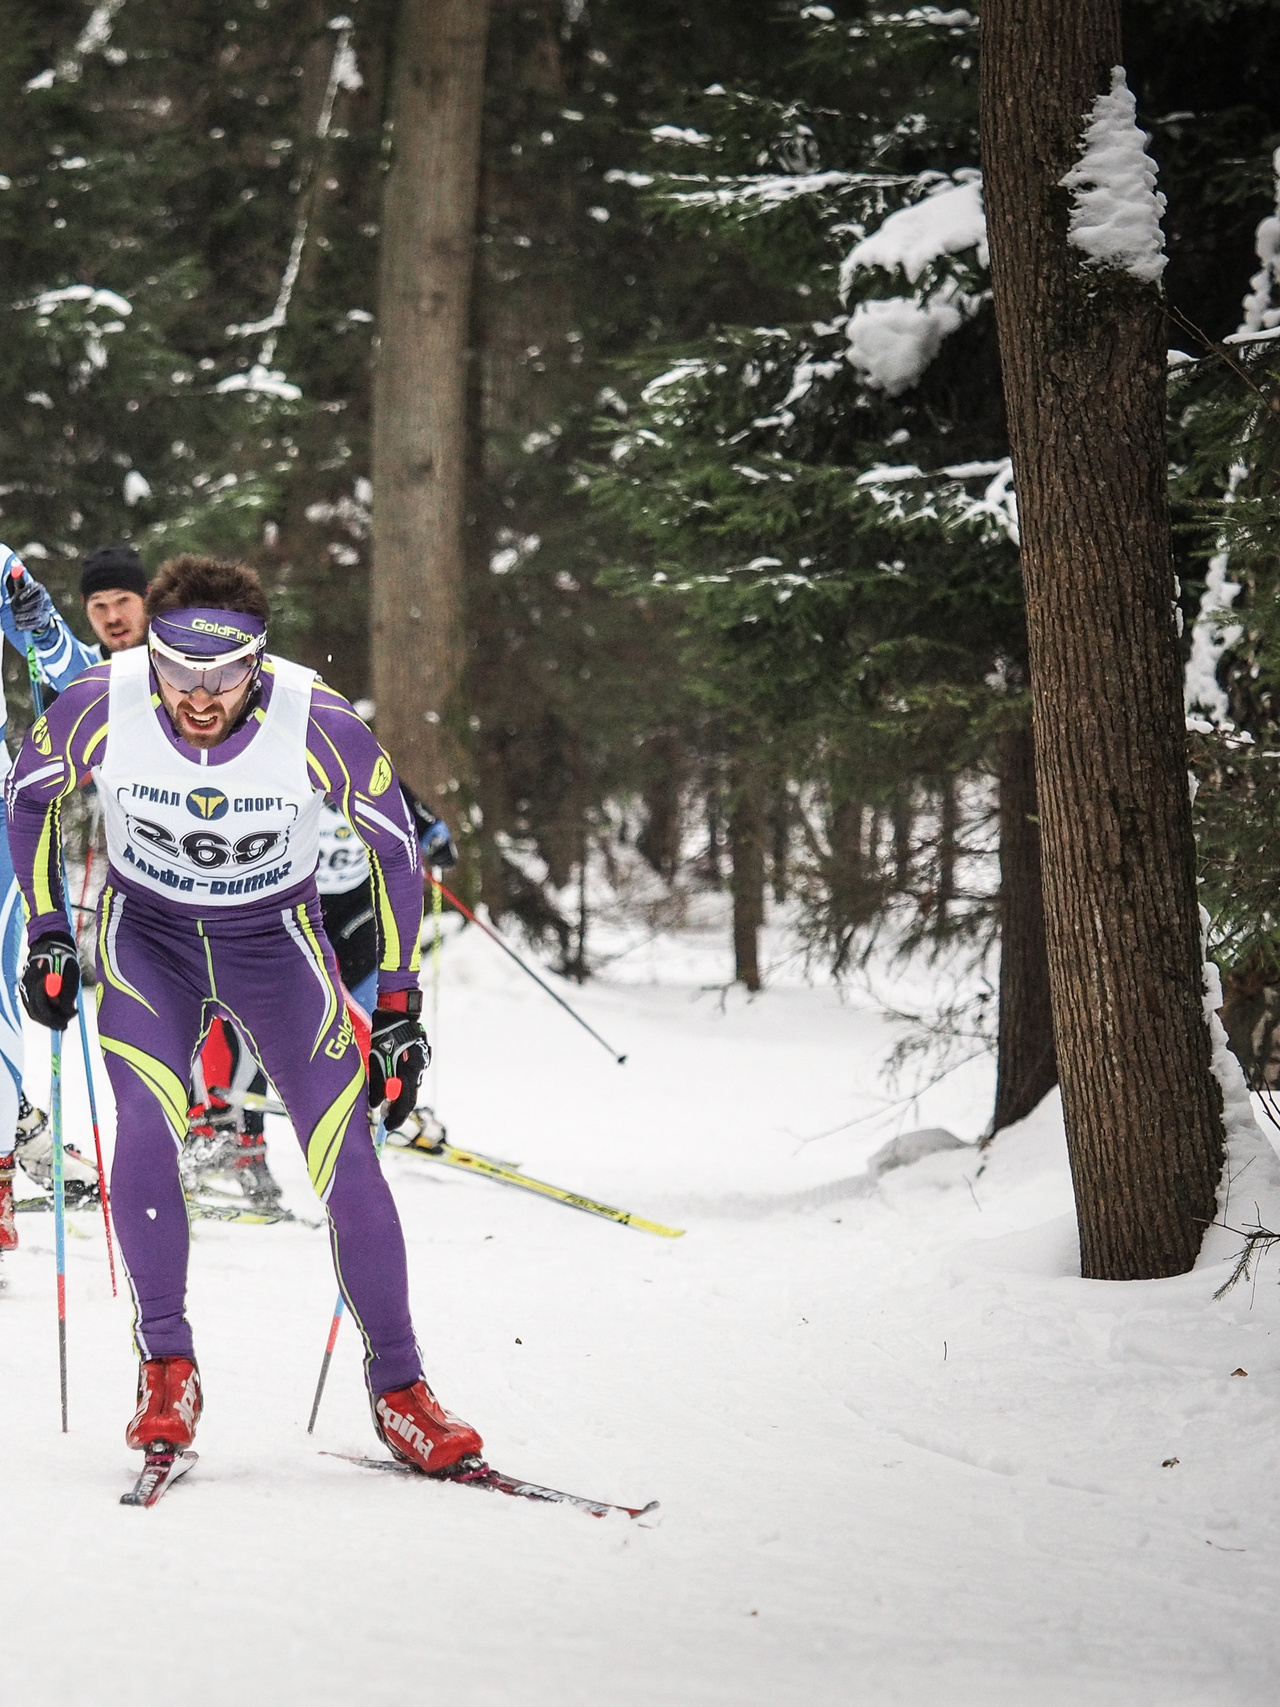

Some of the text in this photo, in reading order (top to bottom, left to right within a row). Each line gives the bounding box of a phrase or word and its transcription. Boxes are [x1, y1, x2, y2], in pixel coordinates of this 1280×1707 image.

[131, 783, 284, 813] ТРИАЛ СПОРТ
[130, 815, 283, 869] 269
